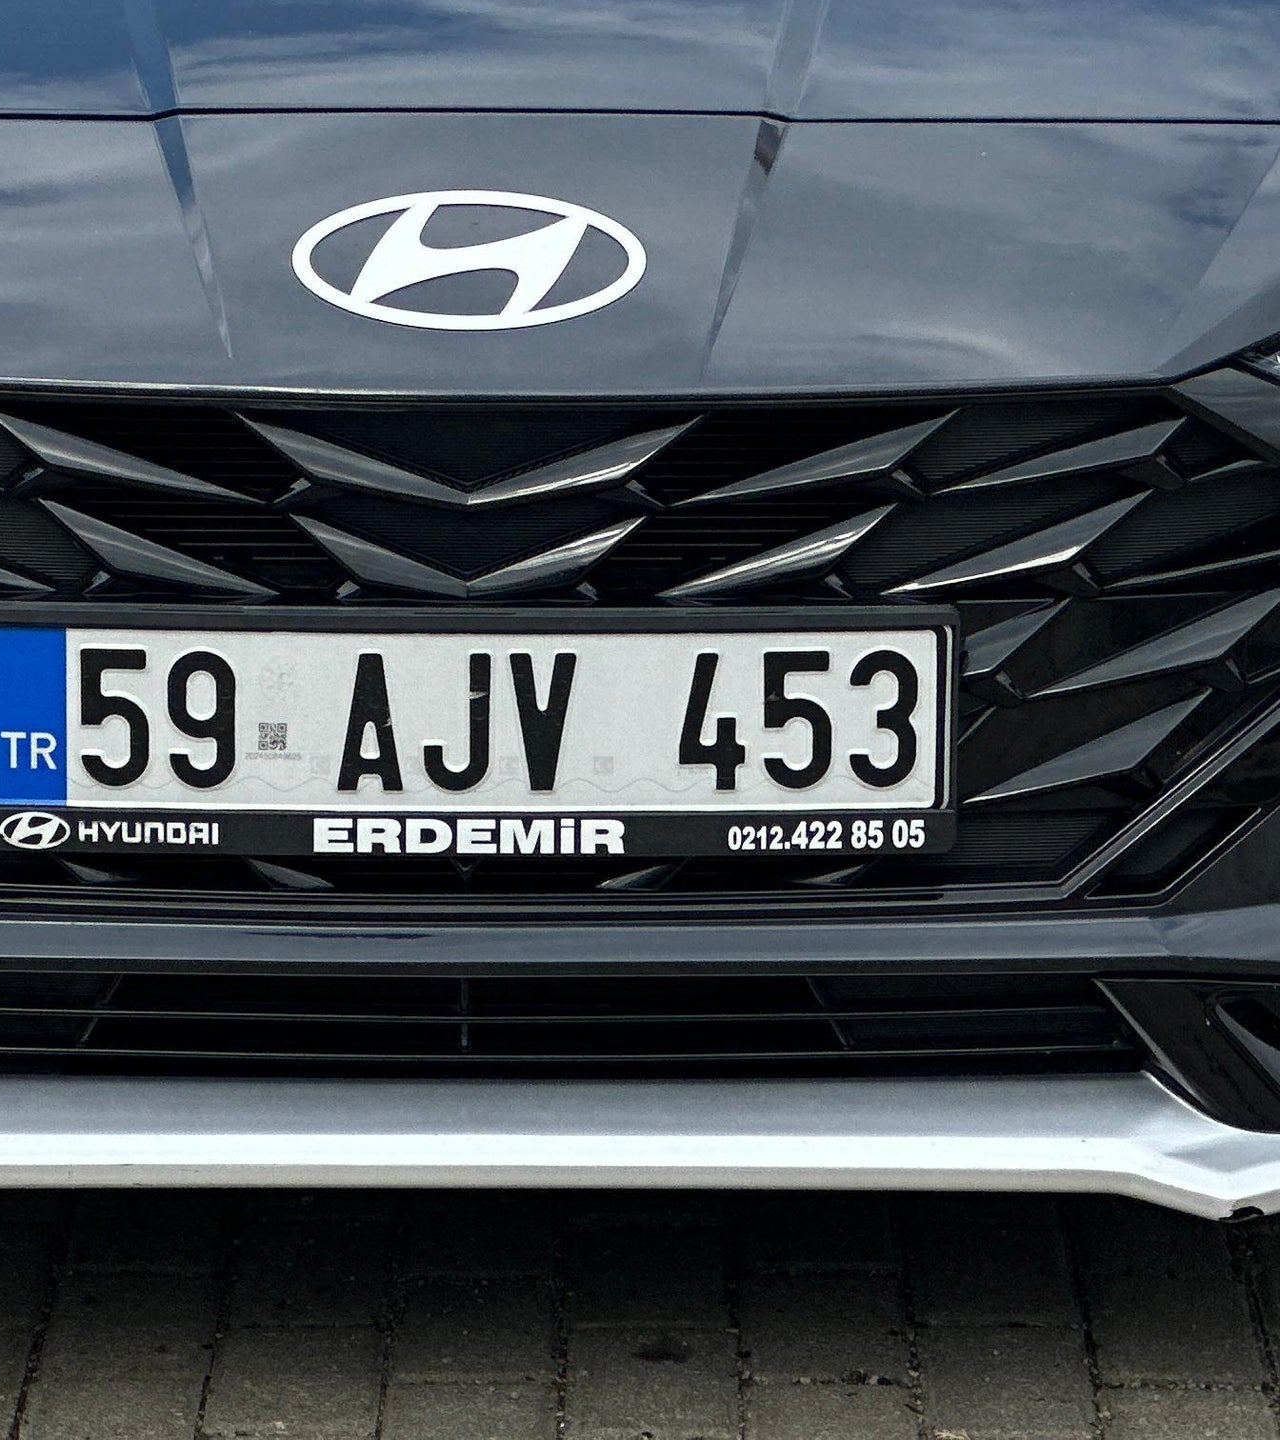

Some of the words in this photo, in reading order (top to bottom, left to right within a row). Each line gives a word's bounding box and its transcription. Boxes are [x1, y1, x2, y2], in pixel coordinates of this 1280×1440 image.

[80, 648, 236, 789] 59
[337, 652, 577, 792] AJV
[678, 649, 919, 790] 453
[0, 731, 57, 770] TR
[78, 819, 219, 845] HYUNDAI
[727, 820, 843, 851] 0212.422
[850, 819, 884, 850] 85
[891, 819, 926, 849] 05
